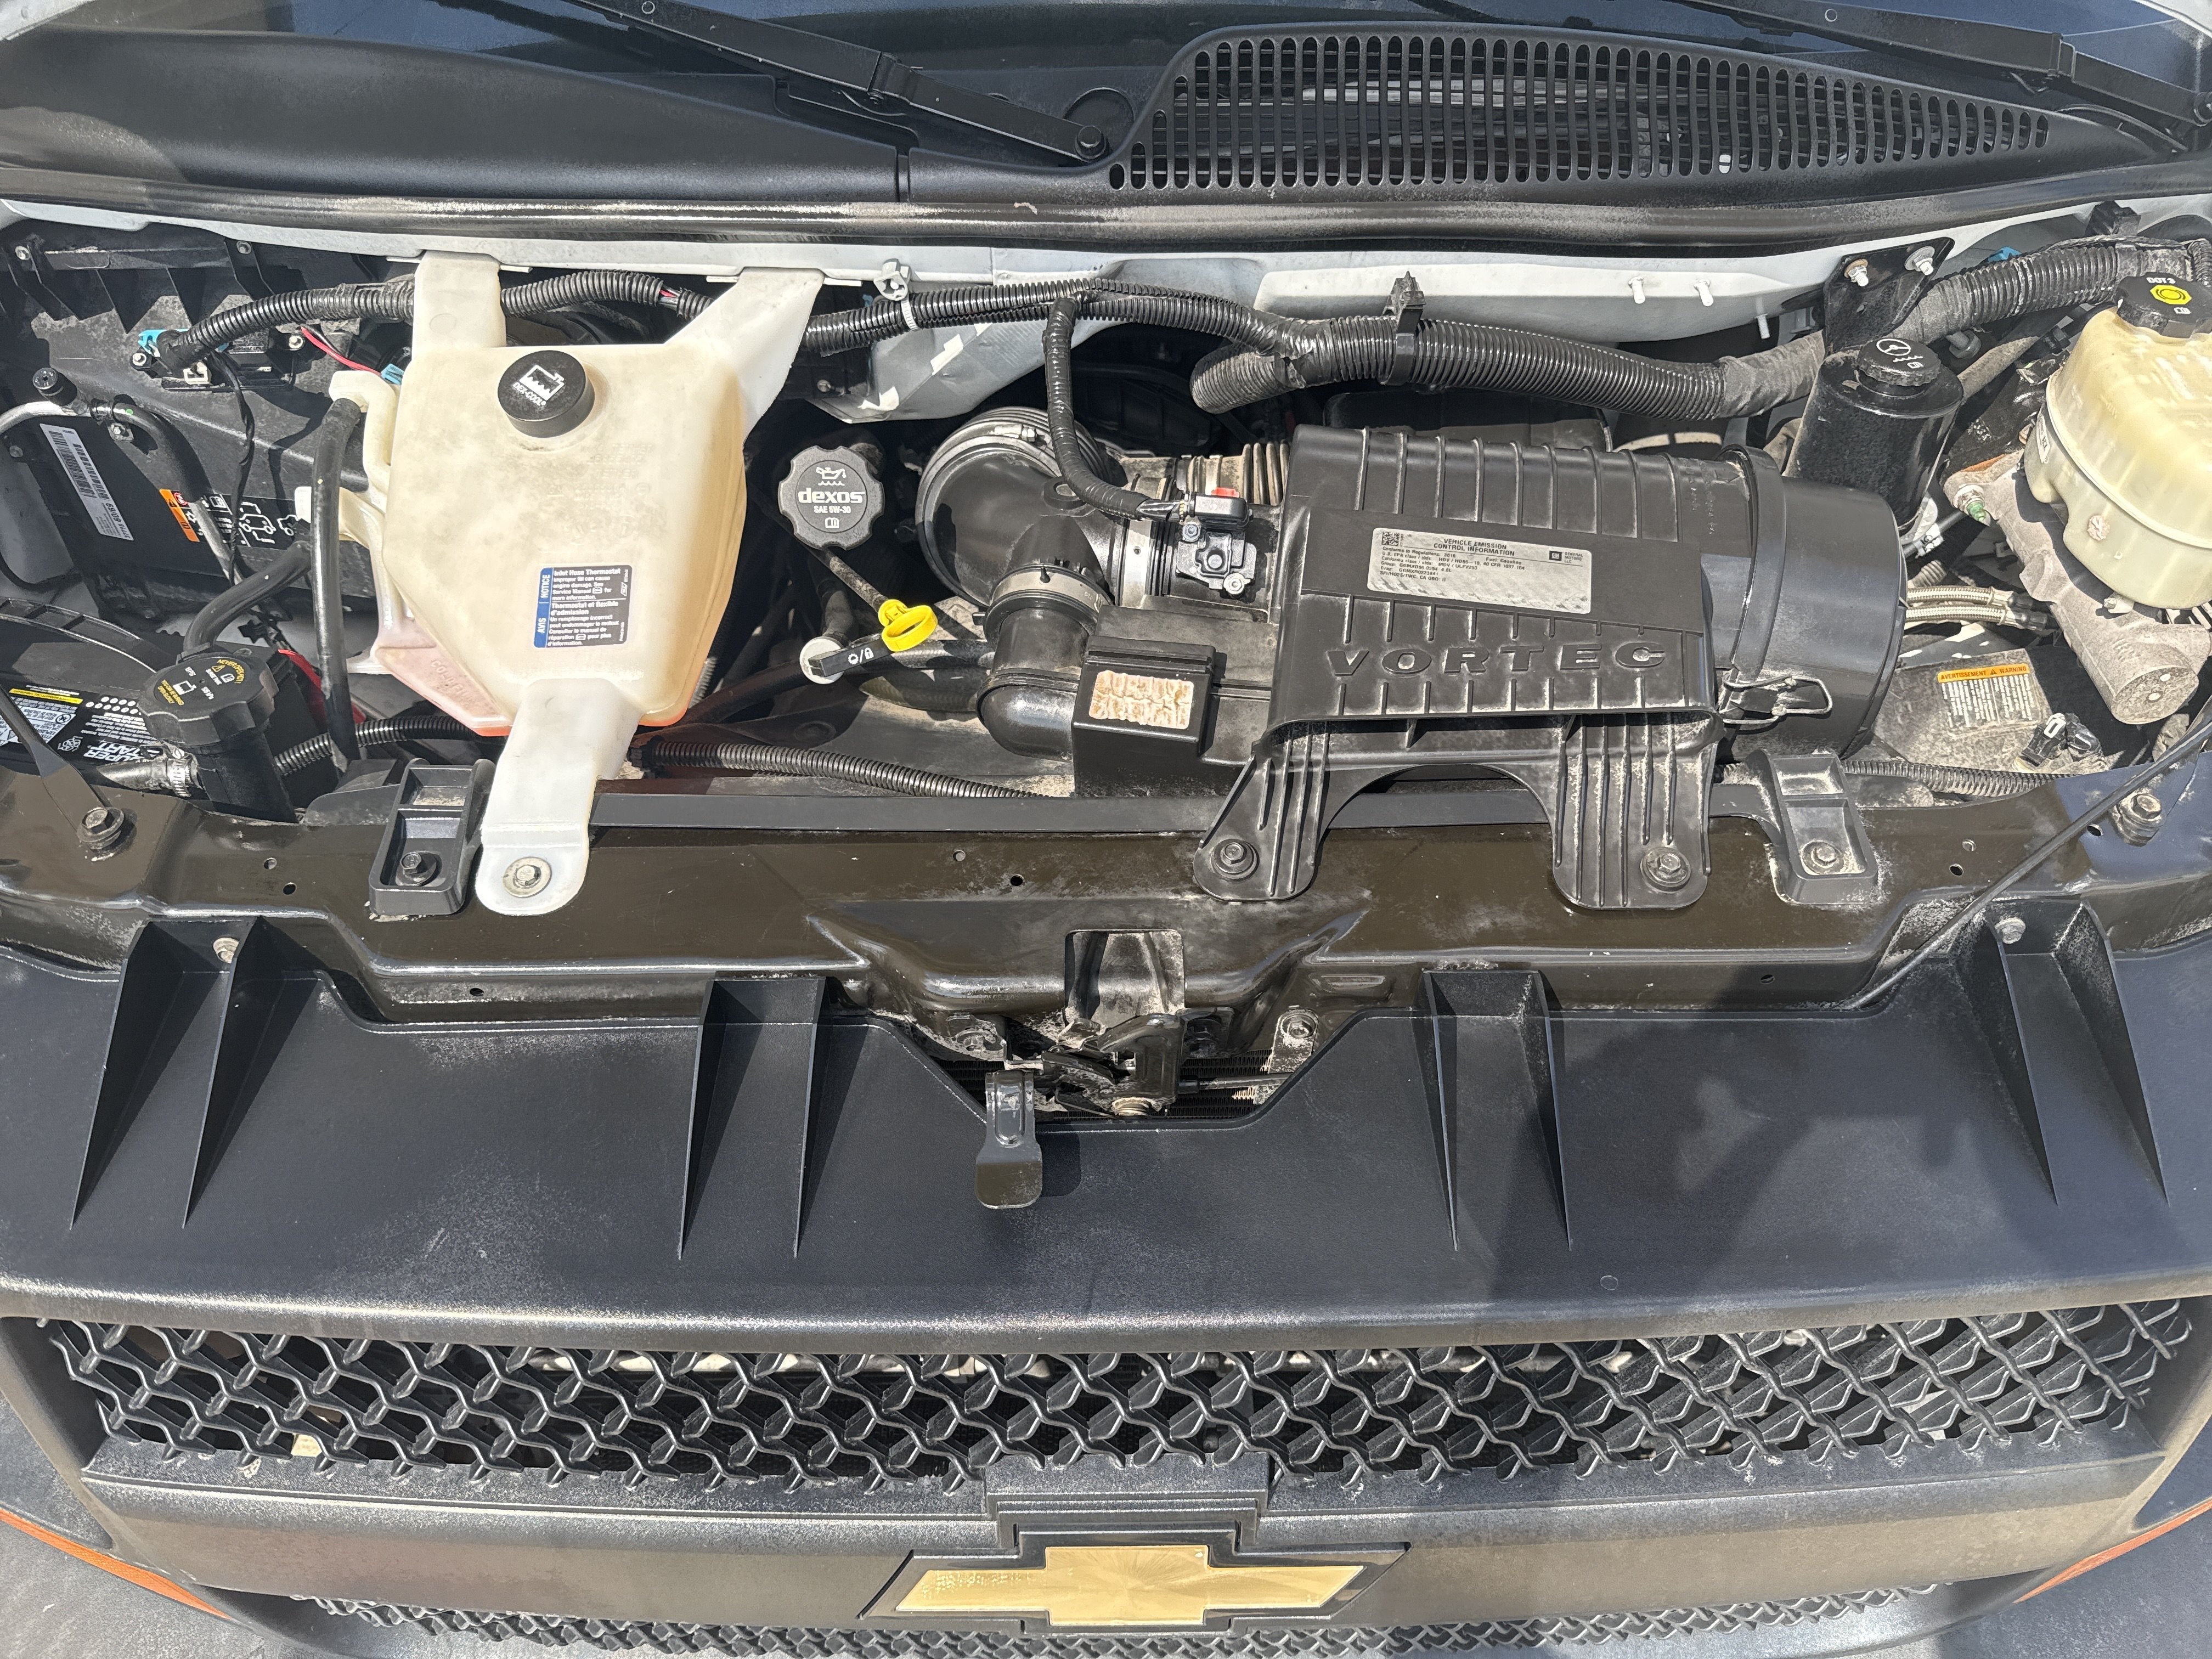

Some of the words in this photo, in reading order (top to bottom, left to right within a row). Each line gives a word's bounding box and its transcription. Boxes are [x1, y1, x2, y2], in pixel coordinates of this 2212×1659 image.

[798, 487, 865, 504] dexos
[105, 503, 122, 522] 60/69
[814, 505, 828, 514] SAE
[829, 505, 851, 514] 5W-30
[1468, 546, 1515, 556] INFORMATION
[540, 574, 550, 598] NOTICE
[537, 618, 546, 633] AVIS
[1327, 642, 1666, 676] VORTEC
[1940, 670, 1986, 680] AVERTISSEMENT
